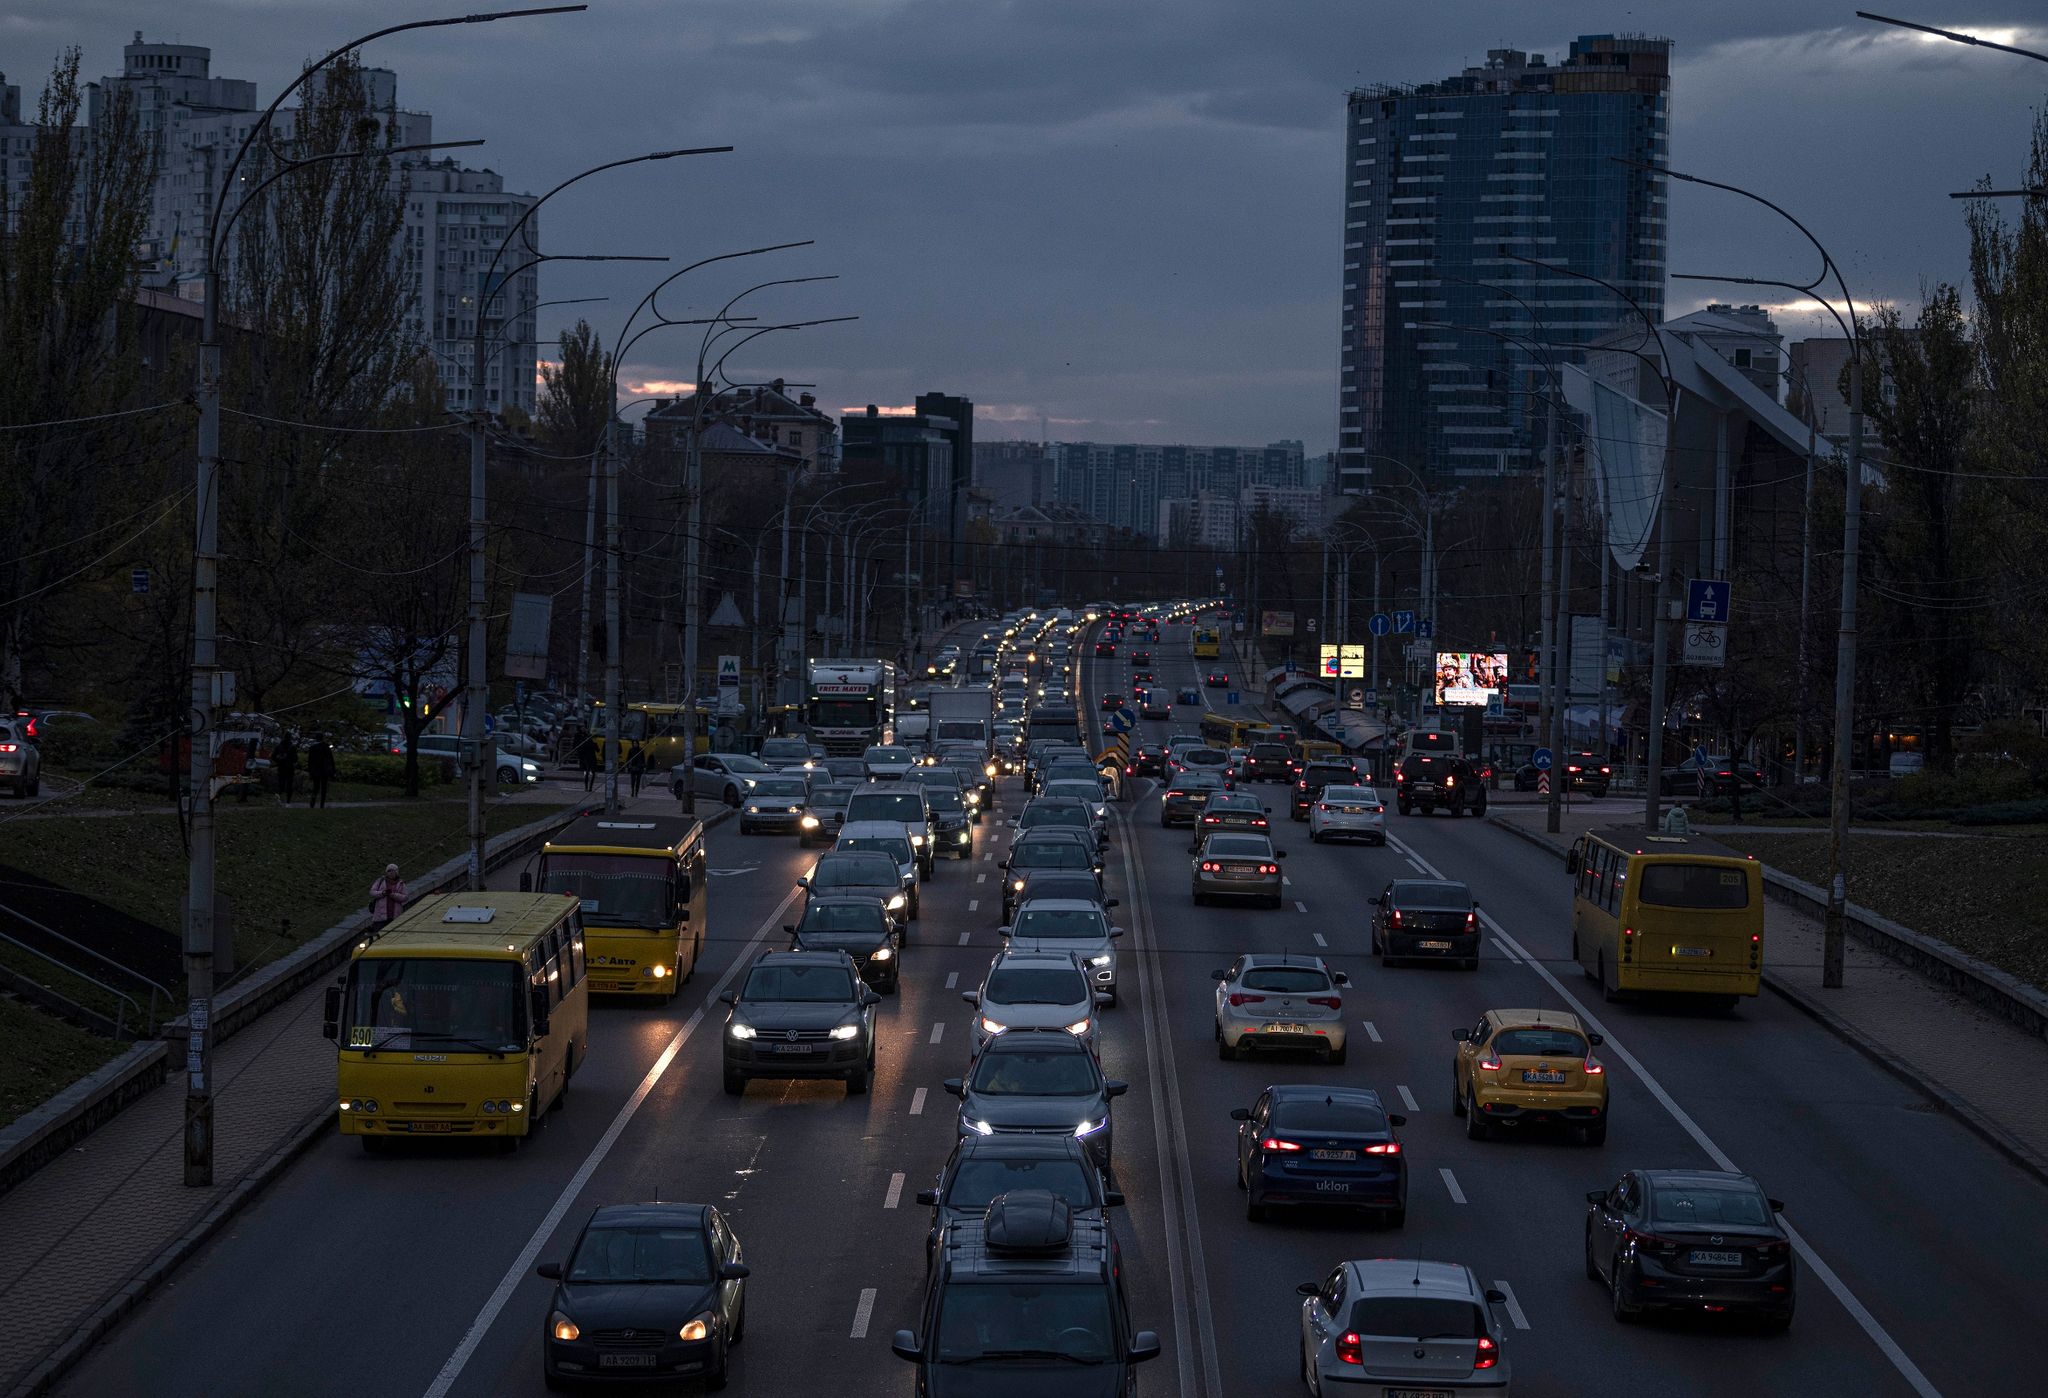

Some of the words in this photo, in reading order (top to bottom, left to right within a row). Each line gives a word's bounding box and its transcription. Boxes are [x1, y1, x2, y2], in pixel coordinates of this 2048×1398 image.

[1723, 874, 1738, 884] 205
[352, 1028, 371, 1045] 590
[1316, 1180, 1349, 1192] uklon
[1695, 1252, 1706, 1260] KA
